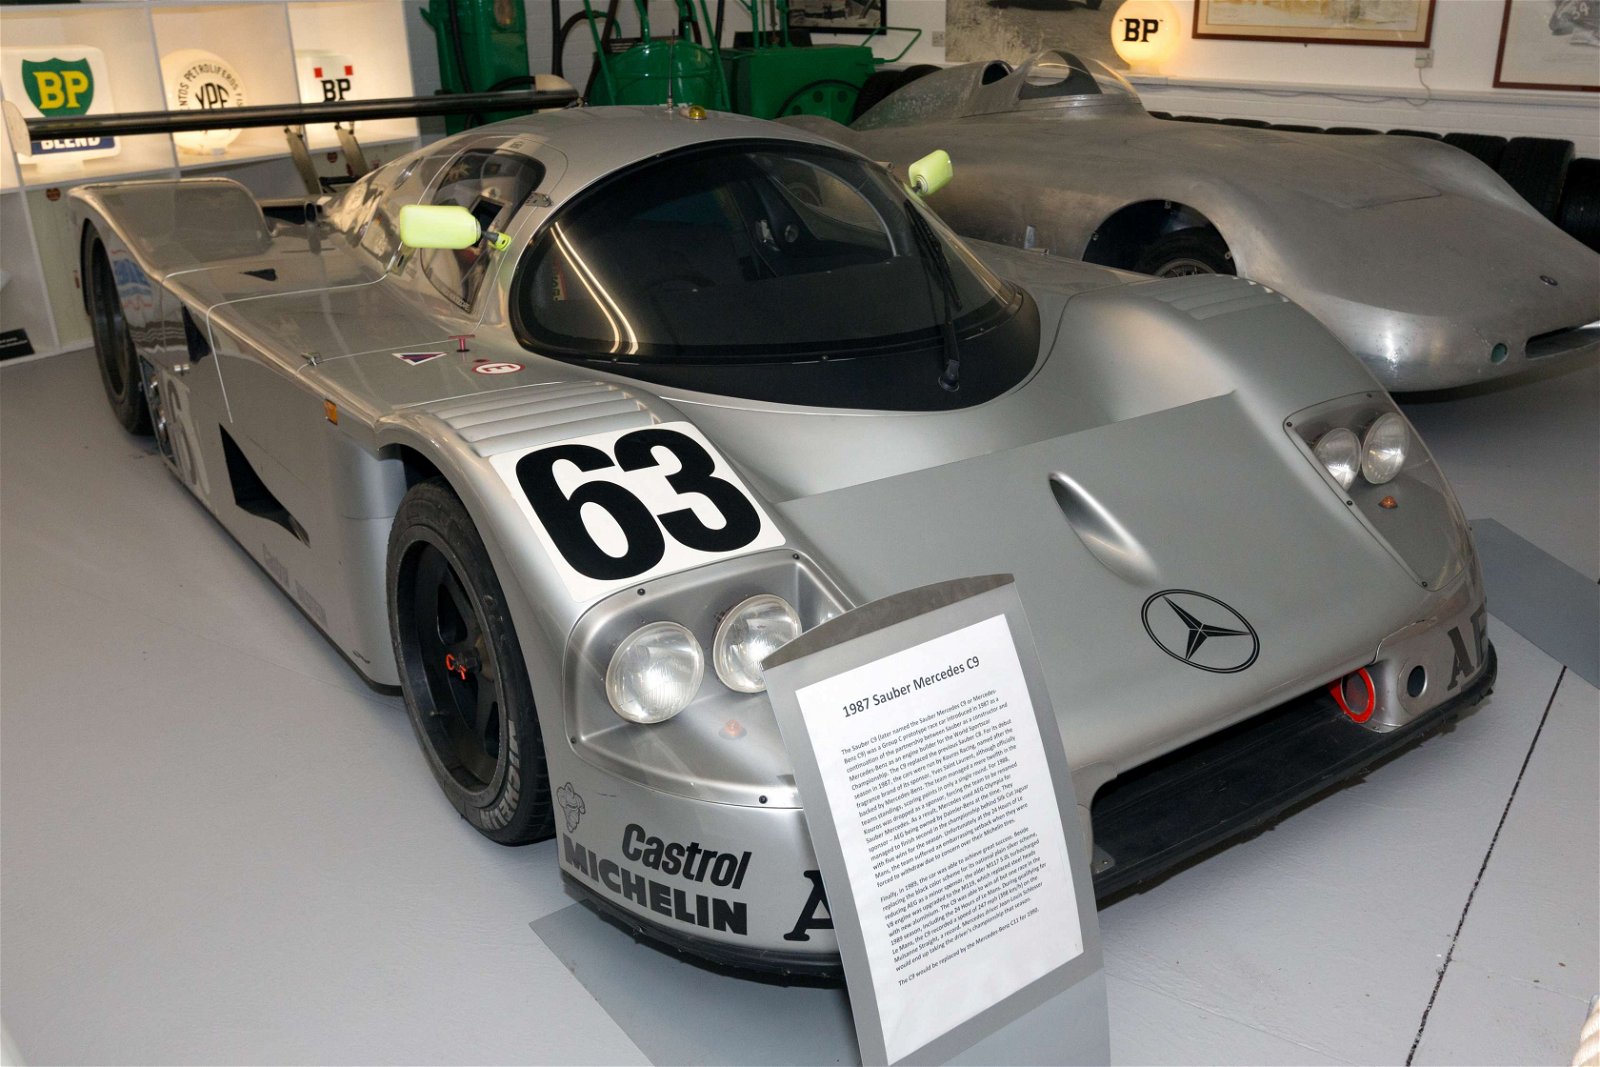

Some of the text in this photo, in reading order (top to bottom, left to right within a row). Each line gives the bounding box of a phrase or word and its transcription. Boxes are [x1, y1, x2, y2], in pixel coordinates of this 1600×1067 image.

[1123, 18, 1159, 42] BP
[33, 70, 89, 109] BP
[321, 78, 351, 102] BP
[515, 428, 761, 580] 63
[843, 656, 978, 718] 1987 Sauber Mercedes C9
[846, 706, 998, 772] continuation partnership between Sauber constructor
[848, 718, 990, 782] Mercedes-Benz engine builder World Sportscar
[851, 689, 996, 751] Sauber (later named Sauber Mercedes Mercedes-
[881, 738, 897, 748] Group
[902, 726, 926, 741] prototype
[946, 706, 972, 722] introduced
[907, 753, 928, 767] replaced
[937, 742, 958, 755] previous
[958, 734, 974, 745] Sauber
[998, 718, 1011, 728] debut
[854, 788, 871, 799] season
[976, 734, 992, 746] named
[993, 731, 1004, 739] after
[856, 794, 880, 808] fragrance
[880, 786, 896, 797] brand
[943, 761, 955, 770] Saint
[975, 743, 996, 756] although
[996, 735, 1014, 747] officially
[858, 804, 877, 817] backed
[947, 763, 969, 778] managed
[986, 749, 1003, 760] twelfth
[893, 807, 914, 821] dropped
[946, 787, 963, 797] forcing
[997, 761, 1017, 774] renamed
[860, 815, 877, 826] teams
[903, 796, 921, 807] scoring
[922, 789, 937, 800] points
[958, 773, 972, 782] single
[866, 832, 883, 843] Sauber
[938, 797, 961, 810] Mercedes
[974, 777, 1003, 794] AEG-Olympia
[868, 840, 888, 852] sponsor
[904, 826, 919, 835] being
[919, 816, 935, 828] owned
[943, 800, 974, 817] Daimler-Benz
[870, 784, 1028, 861] managed finish second championship behind Jaguar
[943, 817, 976, 836] Unfortunately
[997, 801, 1011, 811] Hours
[621, 823, 752, 889] Castrol
[876, 823, 1003, 887] forced withdraw concern their Michelin
[914, 845, 934, 860] suffered
[942, 828, 974, 846] embarrassing
[974, 819, 992, 831] setback
[964, 850, 981, 861] achieve
[982, 842, 994, 853] great
[1013, 826, 1028, 837] Beside
[563, 832, 748, 936] MICHELIN
[882, 896, 905, 911] replacing
[915, 884, 928, 895] black
[929, 878, 941, 888] color
[942, 870, 960, 881] scheme
[975, 851, 993, 865] national
[994, 847, 1005, 857] plain
[1006, 840, 1018, 849] silver
[884, 906, 906, 920] reducing
[928, 887, 943, 898] minor
[1009, 838, 1039, 856] turbocharged
[894, 849, 1035, 924] engine upgraded which replaced steel heads
[922, 915, 945, 929] including
[961, 899, 975, 909] Hours
[1001, 877, 1017, 888] During
[1018, 866, 1039, 880] qualifying
[961, 912, 984, 927] Mercedes
[985, 904, 998, 915] driver
[999, 892, 1022, 907] Jean-Louis
[1022, 881, 1042, 895] Schlesser
[895, 958, 911, 971] would
[929, 942, 944, 953] taking
[954, 928, 971, 940] driver's
[972, 911, 1003, 930] championship
[915, 923, 1010, 976] would replaced Mercedes-Benz
[931, 908, 971, 934] recorded speed
